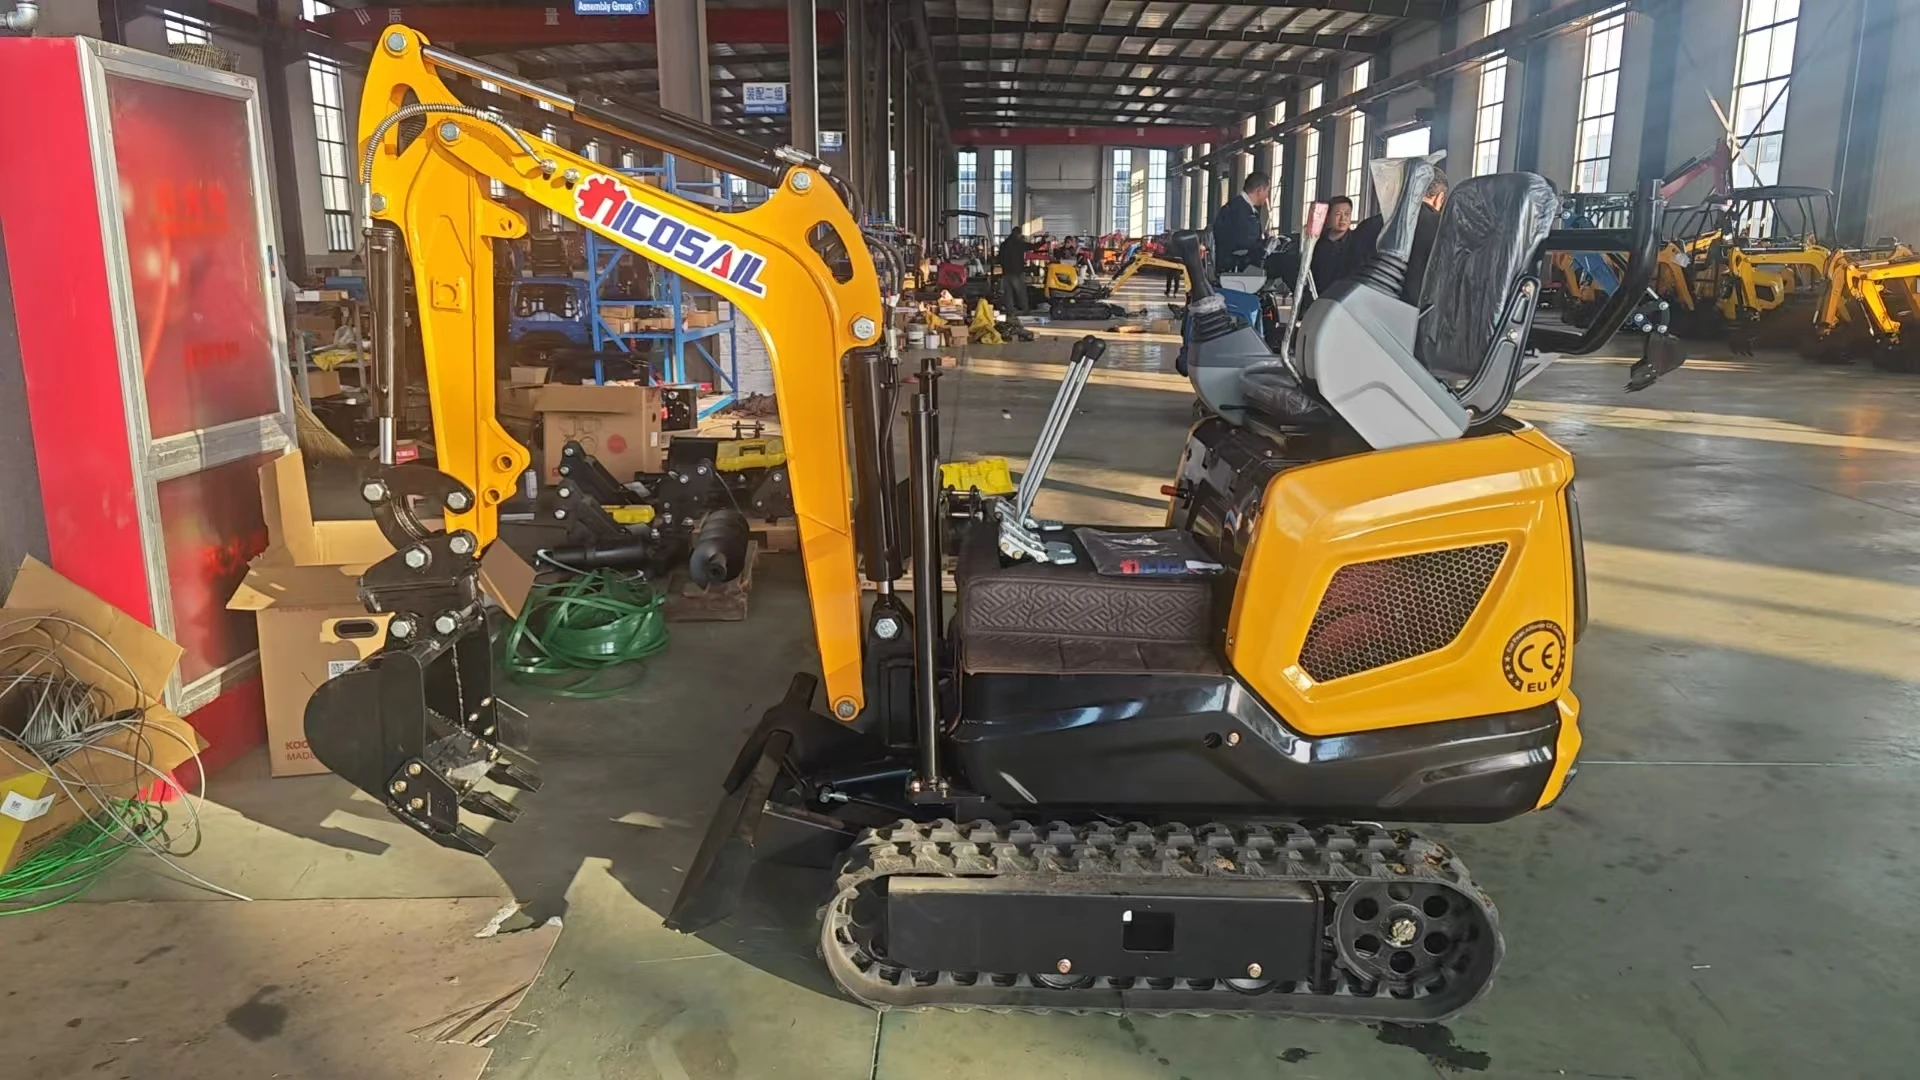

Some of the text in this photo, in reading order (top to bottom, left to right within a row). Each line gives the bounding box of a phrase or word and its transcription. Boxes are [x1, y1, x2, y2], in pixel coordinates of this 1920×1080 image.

[578, 1, 610, 12] Assembly
[612, 1, 633, 12] Group
[544, 7, 560, 25] 量
[1518, 641, 1555, 673] CE
[1527, 682, 1547, 693] EU
